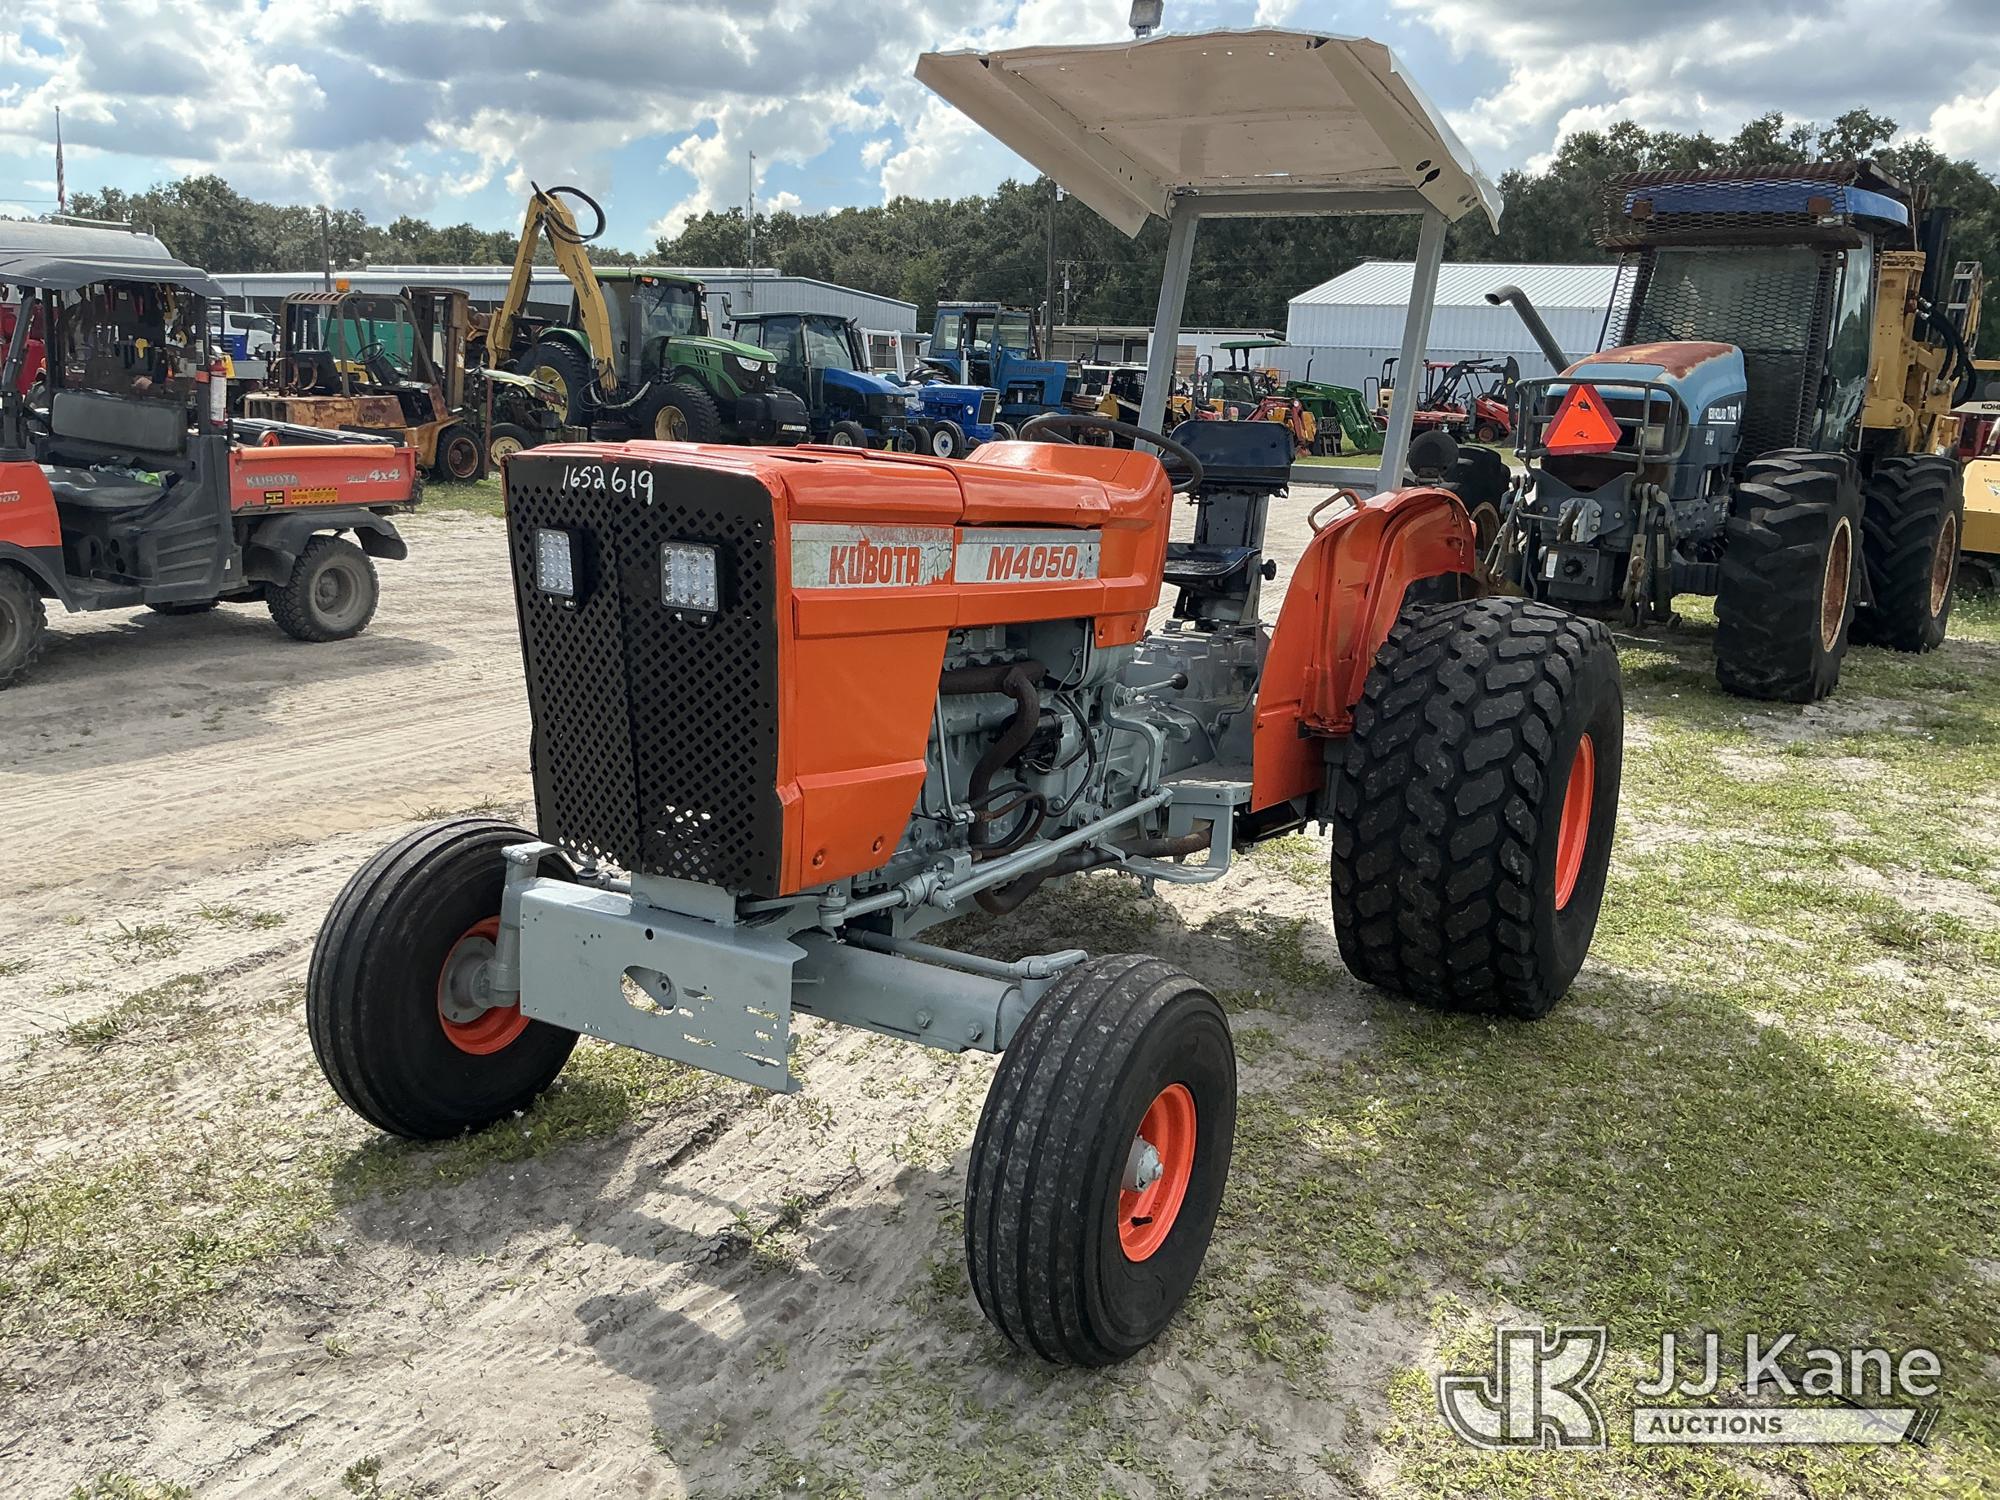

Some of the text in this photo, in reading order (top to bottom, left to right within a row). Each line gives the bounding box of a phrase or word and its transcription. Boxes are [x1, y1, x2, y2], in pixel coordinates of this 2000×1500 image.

[246, 473, 299, 487] KUBOTA
[368, 468, 401, 481] 4x4
[562, 465, 654, 506] 1652619
[829, 543, 922, 585] KUBOTA
[986, 545, 1078, 581] M4050
